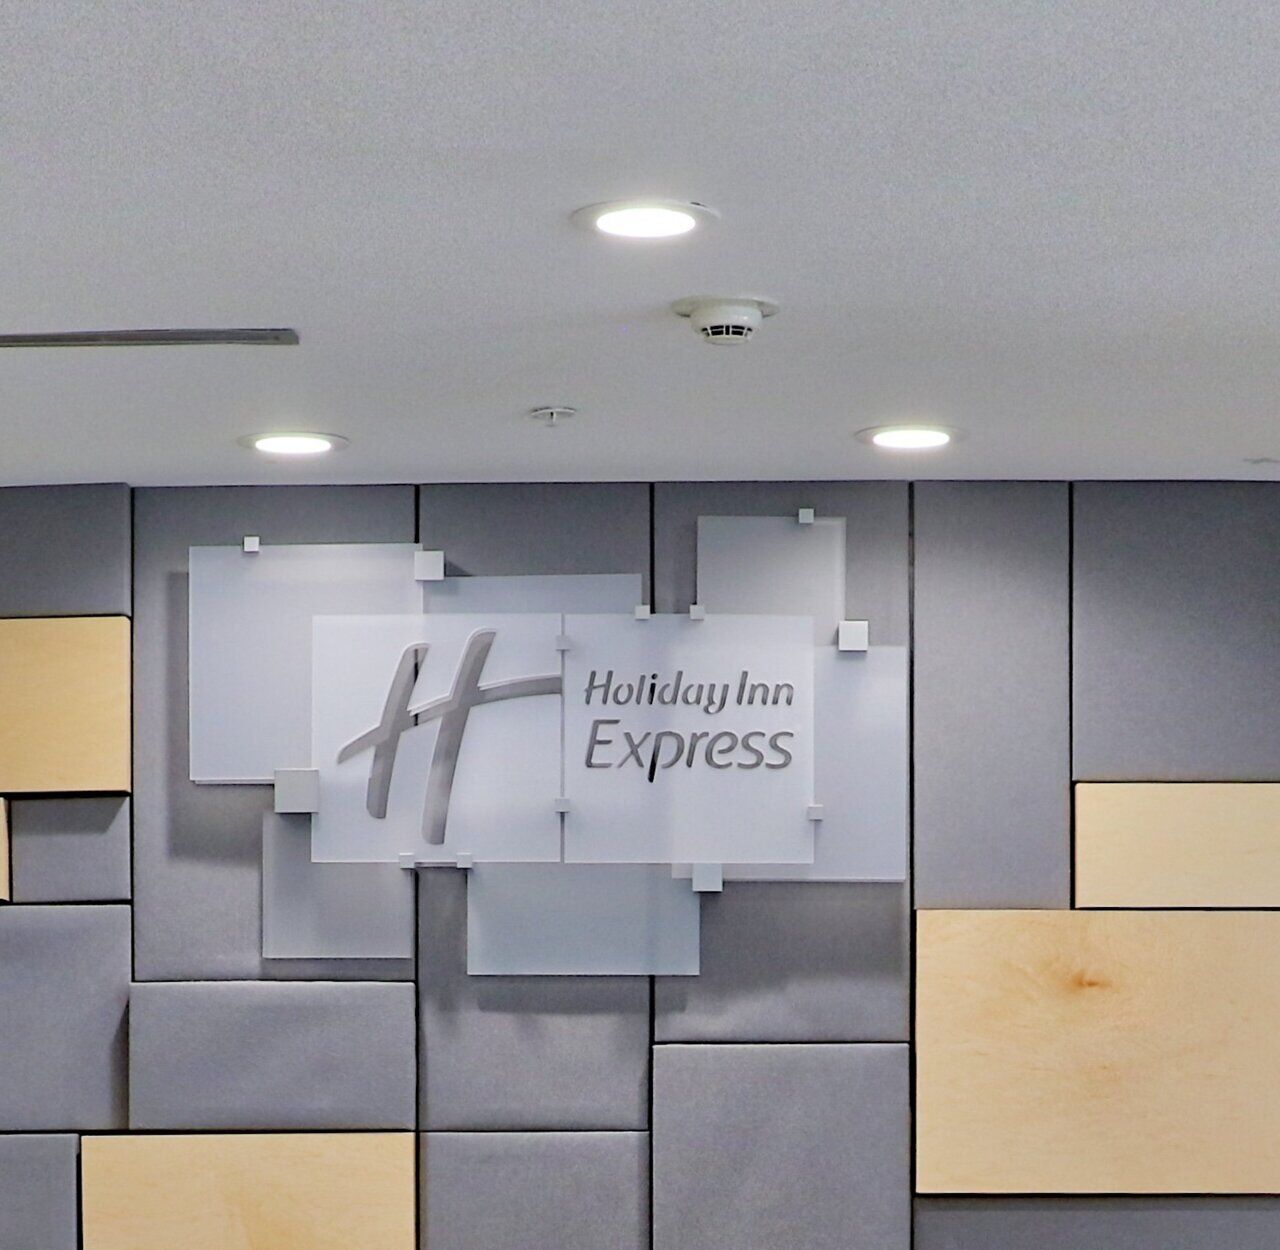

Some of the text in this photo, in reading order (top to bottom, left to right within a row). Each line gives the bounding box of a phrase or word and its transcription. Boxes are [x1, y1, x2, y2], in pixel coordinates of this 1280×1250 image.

[585, 670, 795, 714] Holiday Inn
[585, 718, 795, 784] Express
